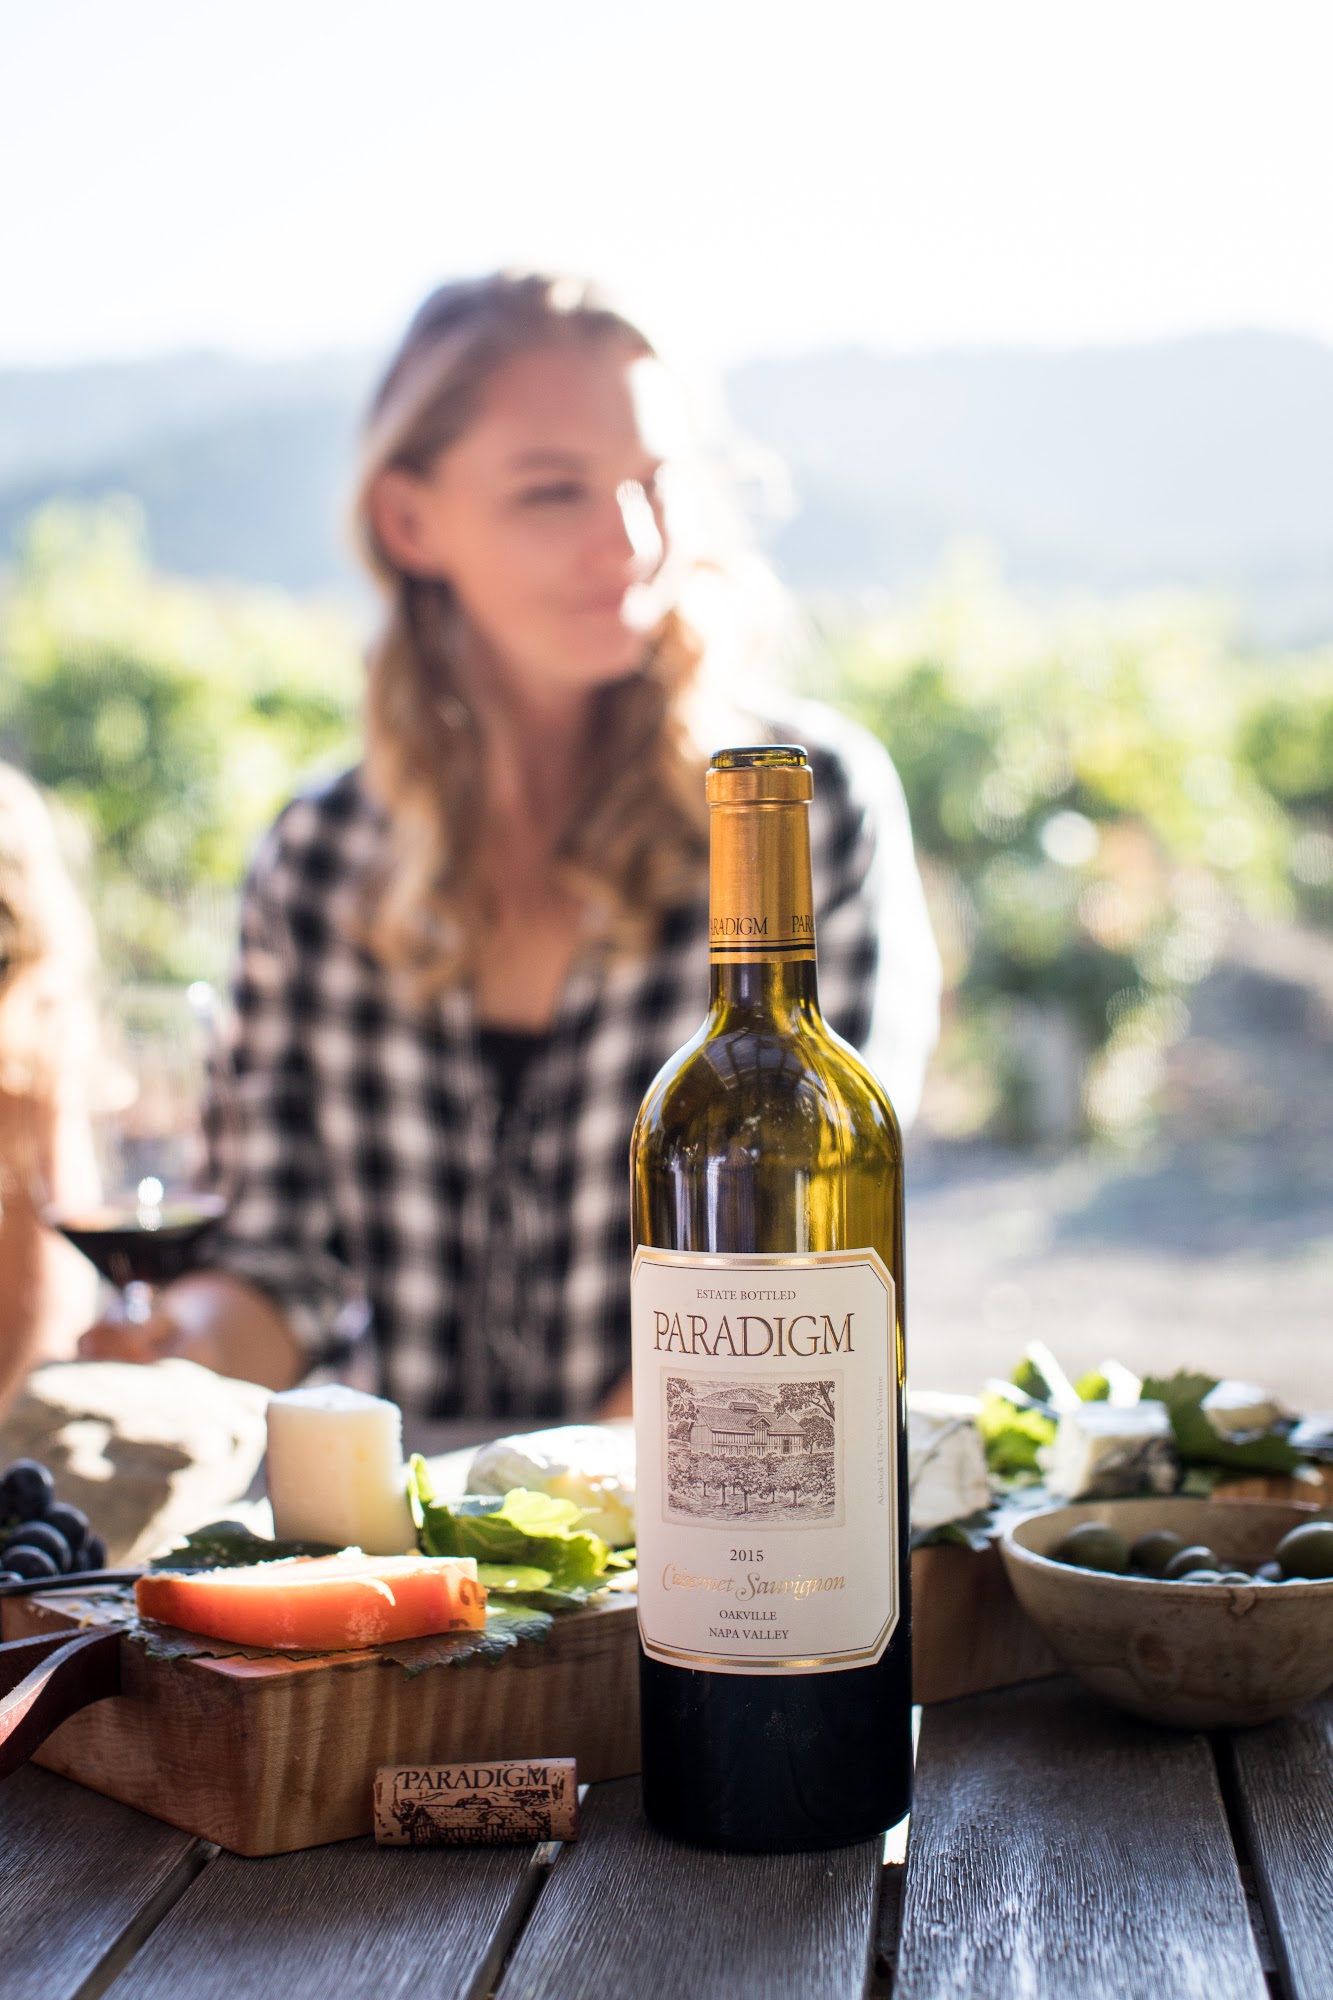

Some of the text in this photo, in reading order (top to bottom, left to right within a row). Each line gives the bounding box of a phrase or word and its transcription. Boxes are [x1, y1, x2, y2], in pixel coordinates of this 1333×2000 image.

[696, 1288, 796, 1301] ESTATE BOTTLED
[653, 1310, 855, 1357] PARADIGM
[877, 1418, 884, 1431] by
[730, 1549, 764, 1562] 2015
[661, 1563, 846, 1601] Cabernet Sauvignon
[719, 1609, 777, 1621] OAKVILLE
[709, 1627, 789, 1640] NAPA VALLEY
[402, 1767, 550, 1790] PARADIGM
